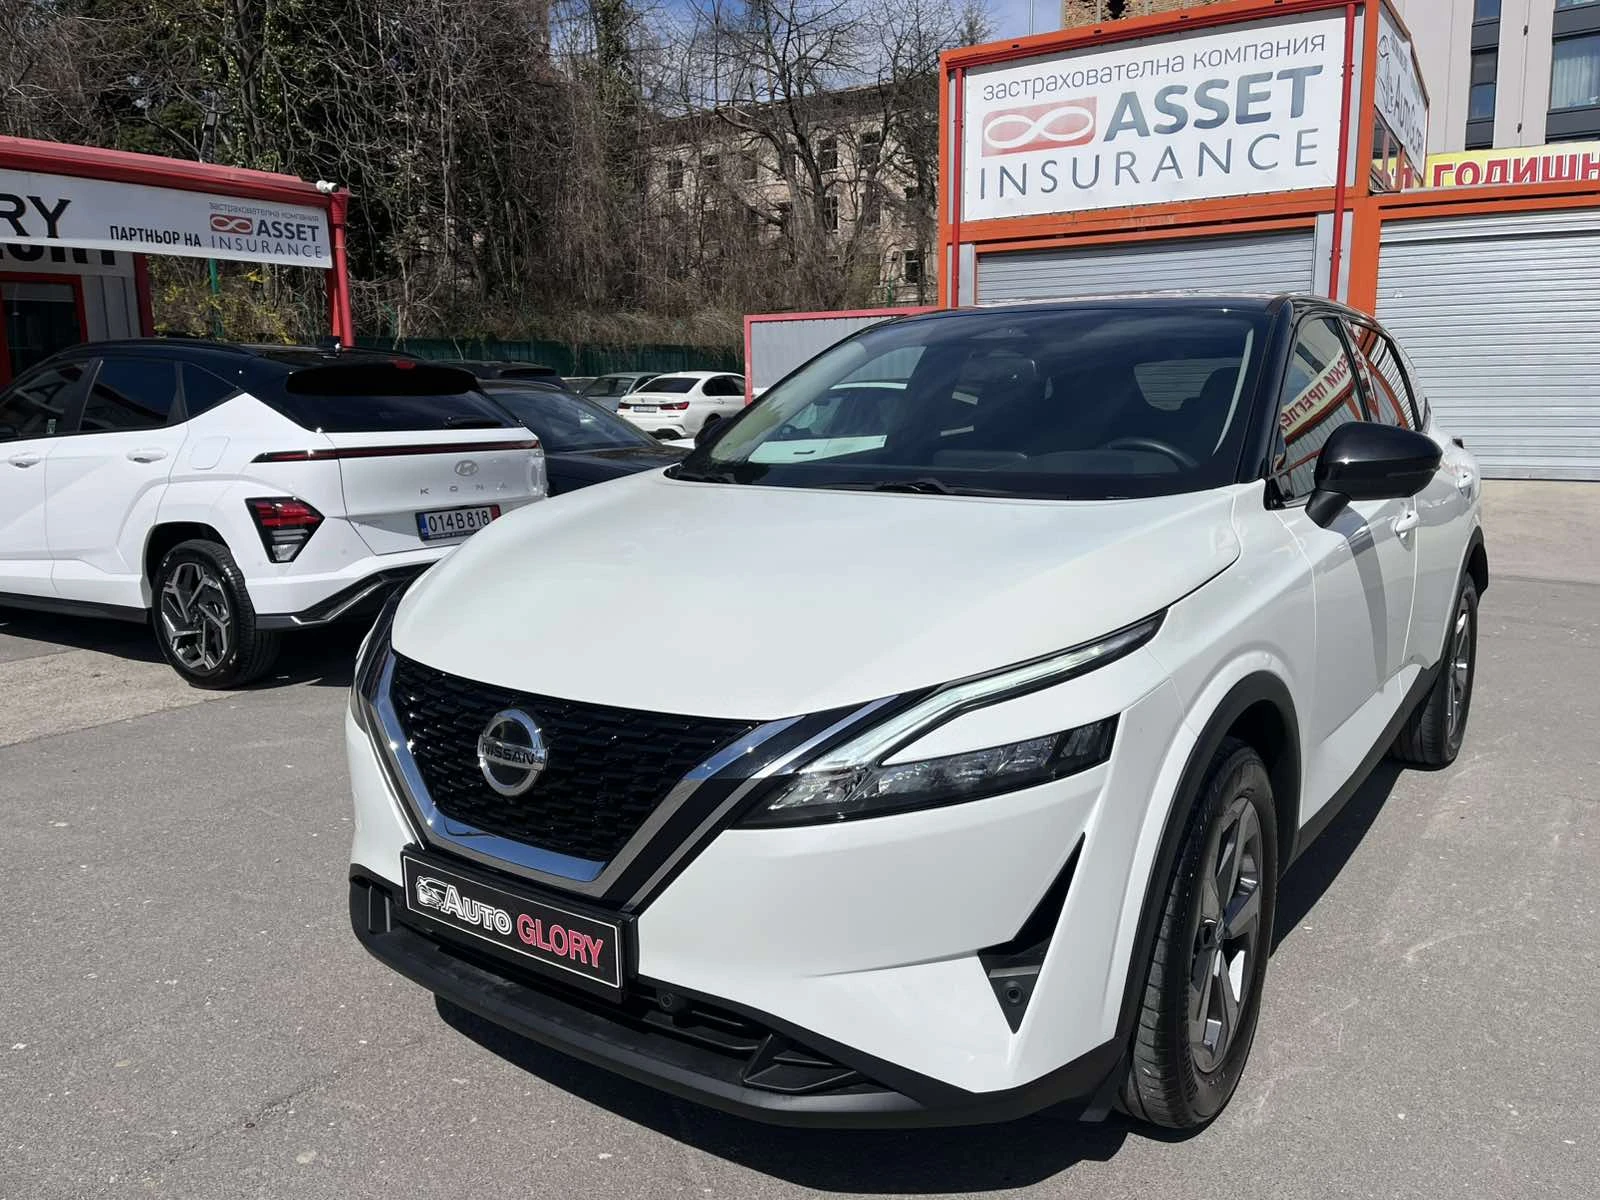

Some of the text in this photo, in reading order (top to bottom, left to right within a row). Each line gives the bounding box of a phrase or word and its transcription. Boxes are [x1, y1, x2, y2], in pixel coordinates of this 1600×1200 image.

[983, 34, 1326, 101] застрахователна компания
[1103, 64, 1324, 142] ASSET
[980, 128, 1320, 200] INSURANCE
[110, 225, 202, 247] ПАРТНЬОР НА
[211, 235, 322, 259] INSURANCE
[256, 219, 320, 242] ASSET
[482, 742, 536, 765] NISSAN
[516, 913, 604, 968] GLORY
